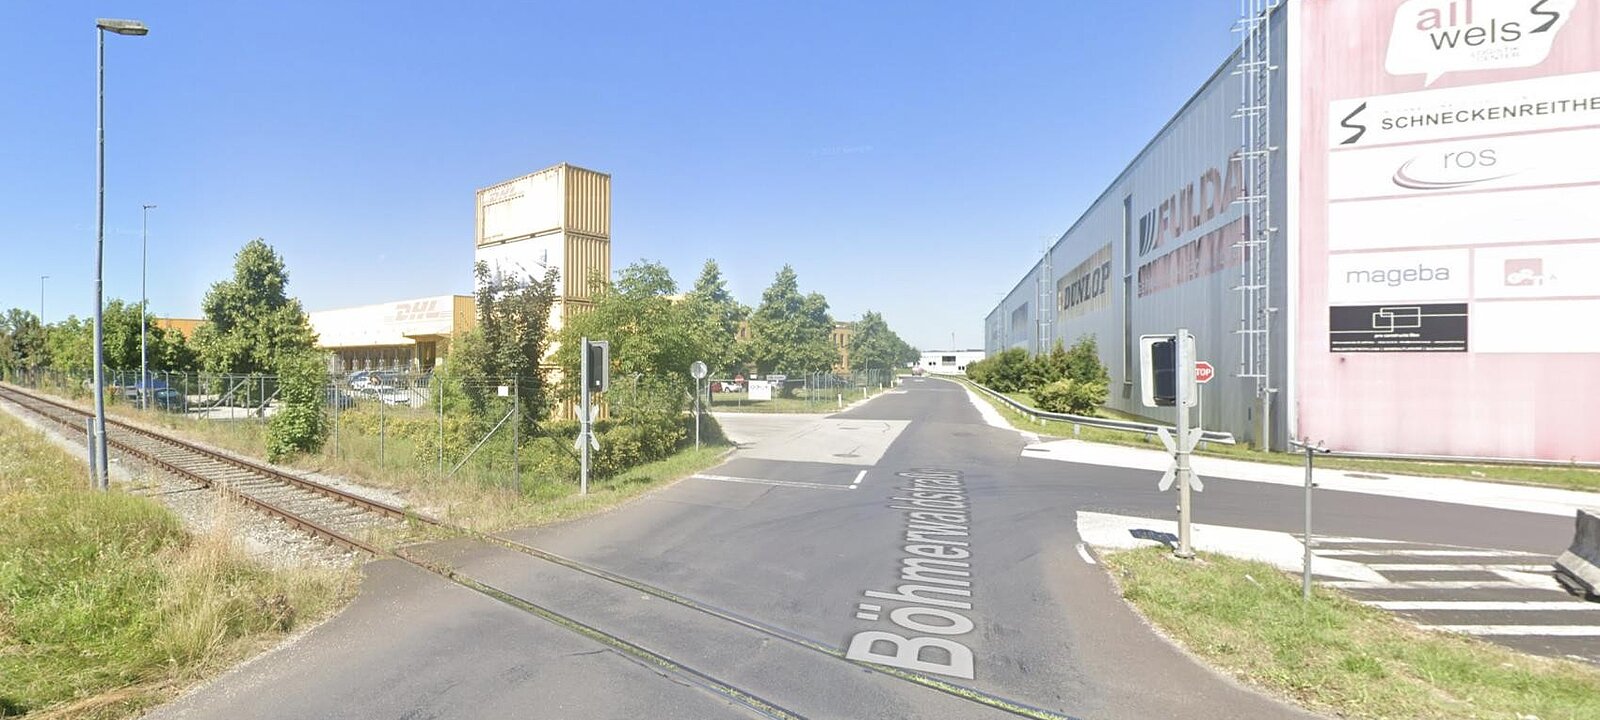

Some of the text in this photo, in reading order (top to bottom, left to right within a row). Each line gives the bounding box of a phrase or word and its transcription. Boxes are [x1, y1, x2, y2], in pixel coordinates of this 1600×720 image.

[1416, 0, 1473, 31] all
[1430, 18, 1522, 50] wels
[1443, 149, 1497, 169] ros
[1153, 149, 1247, 249] FULDA
[1064, 260, 1111, 310] DUNLOP
[1346, 264, 1450, 287] mageba
[395, 300, 441, 321] DHL
[1194, 367, 1212, 377] TOP
